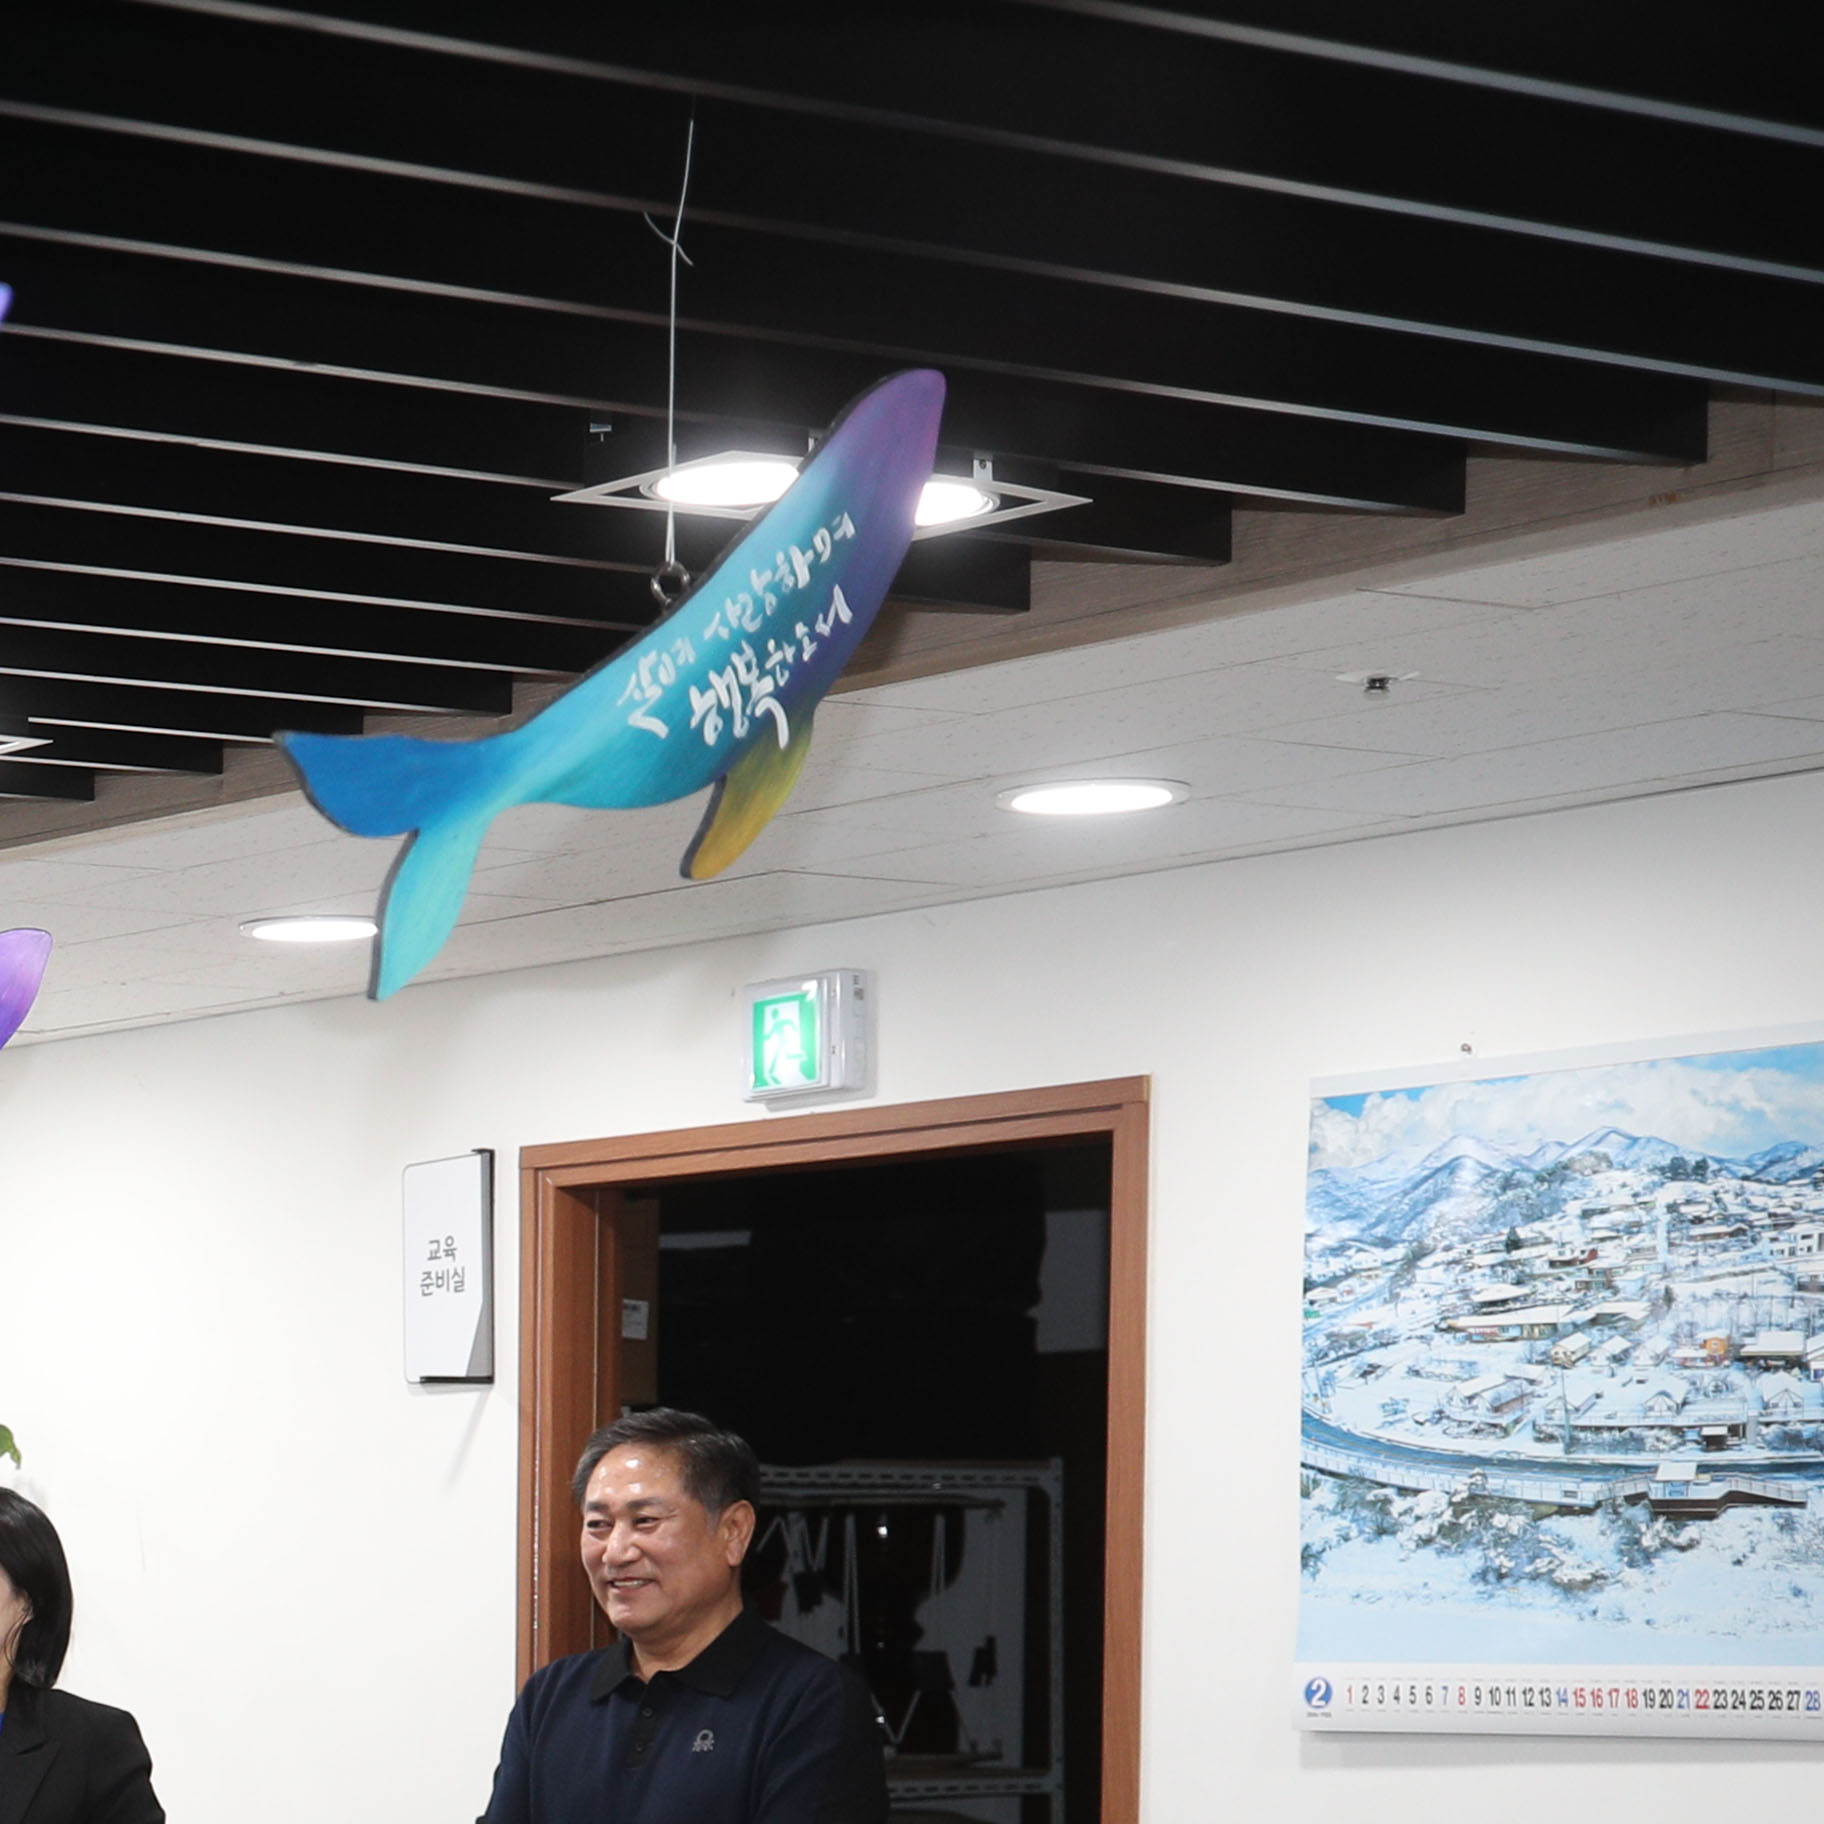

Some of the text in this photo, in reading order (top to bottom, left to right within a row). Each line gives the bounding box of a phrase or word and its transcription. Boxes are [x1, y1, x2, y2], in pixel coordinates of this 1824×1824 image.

[703, 511, 856, 641] 사랑하며
[426, 1235, 459, 1261] 교육
[419, 1265, 467, 1297] 준비실
[1310, 1679, 1328, 1708] 2
[1345, 1685, 1822, 1710] 1 2 3 4 5 6 7 8 9 10 11 12 13 14 15 16 17 18 19 20 21 22 23 24 25 26 27 28
